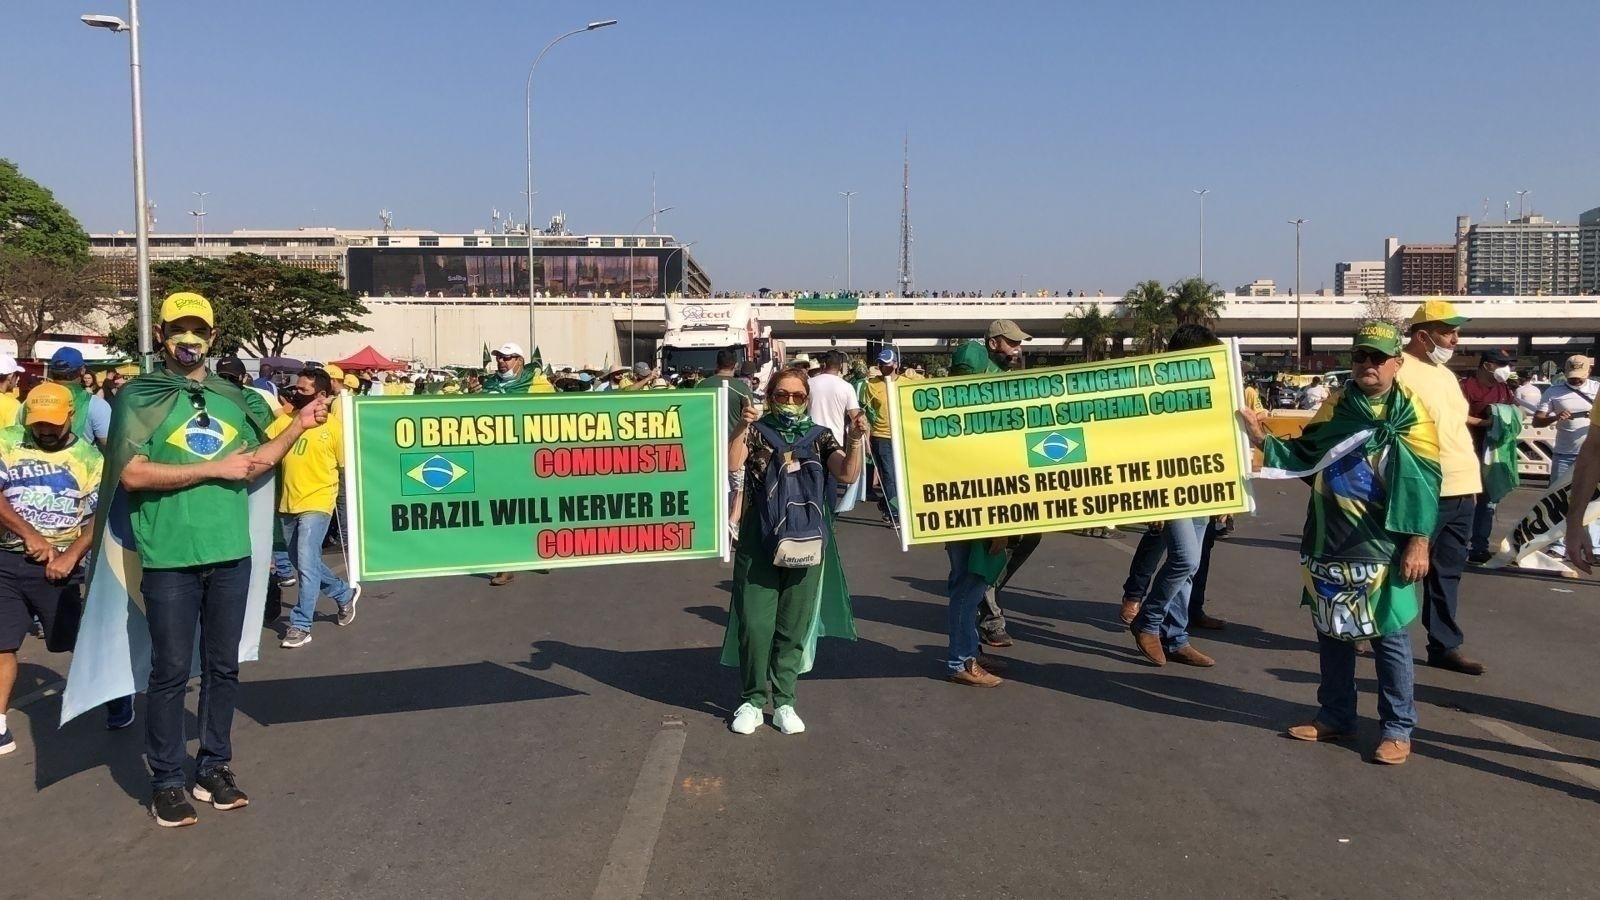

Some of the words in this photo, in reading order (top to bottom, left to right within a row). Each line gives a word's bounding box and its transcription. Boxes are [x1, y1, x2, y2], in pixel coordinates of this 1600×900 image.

[913, 388, 941, 411] OS
[942, 374, 1065, 409] BRASILEIROS
[1066, 366, 1137, 395] EXIGEM
[1138, 364, 1155, 387] A
[1154, 357, 1215, 385] SAIDA
[395, 417, 416, 448] O
[420, 415, 519, 447] BRASIL
[523, 411, 614, 444] NUNCA
[617, 405, 683, 440] SERÁ
[921, 414, 962, 440] DOS
[964, 407, 1025, 435] JUIZES
[1026, 404, 1056, 428] DA
[1056, 393, 1149, 425] SUPREMA
[1149, 386, 1212, 415] CORTE
[293, 438, 308, 455] 10
[534, 444, 687, 478] COMUNISTA
[8, 463, 63, 481] RASIL
[923, 474, 1030, 502] BRAZILIANS
[1035, 464, 1113, 492] REQUIRE
[1117, 462, 1151, 483] THE
[1156, 453, 1225, 479] JUDGES
[391, 500, 484, 532] BRAZIL
[489, 497, 552, 525] WILL
[559, 492, 653, 522] NERVER
[660, 490, 689, 517] BE
[916, 511, 940, 532] TO
[945, 507, 983, 529] EXIT
[987, 502, 1039, 525] FROM
[1044, 498, 1078, 519] THE
[1083, 488, 1170, 516] SUPREME
[1174, 481, 1236, 506] COURT
[537, 521, 695, 558] COMMUNIST
